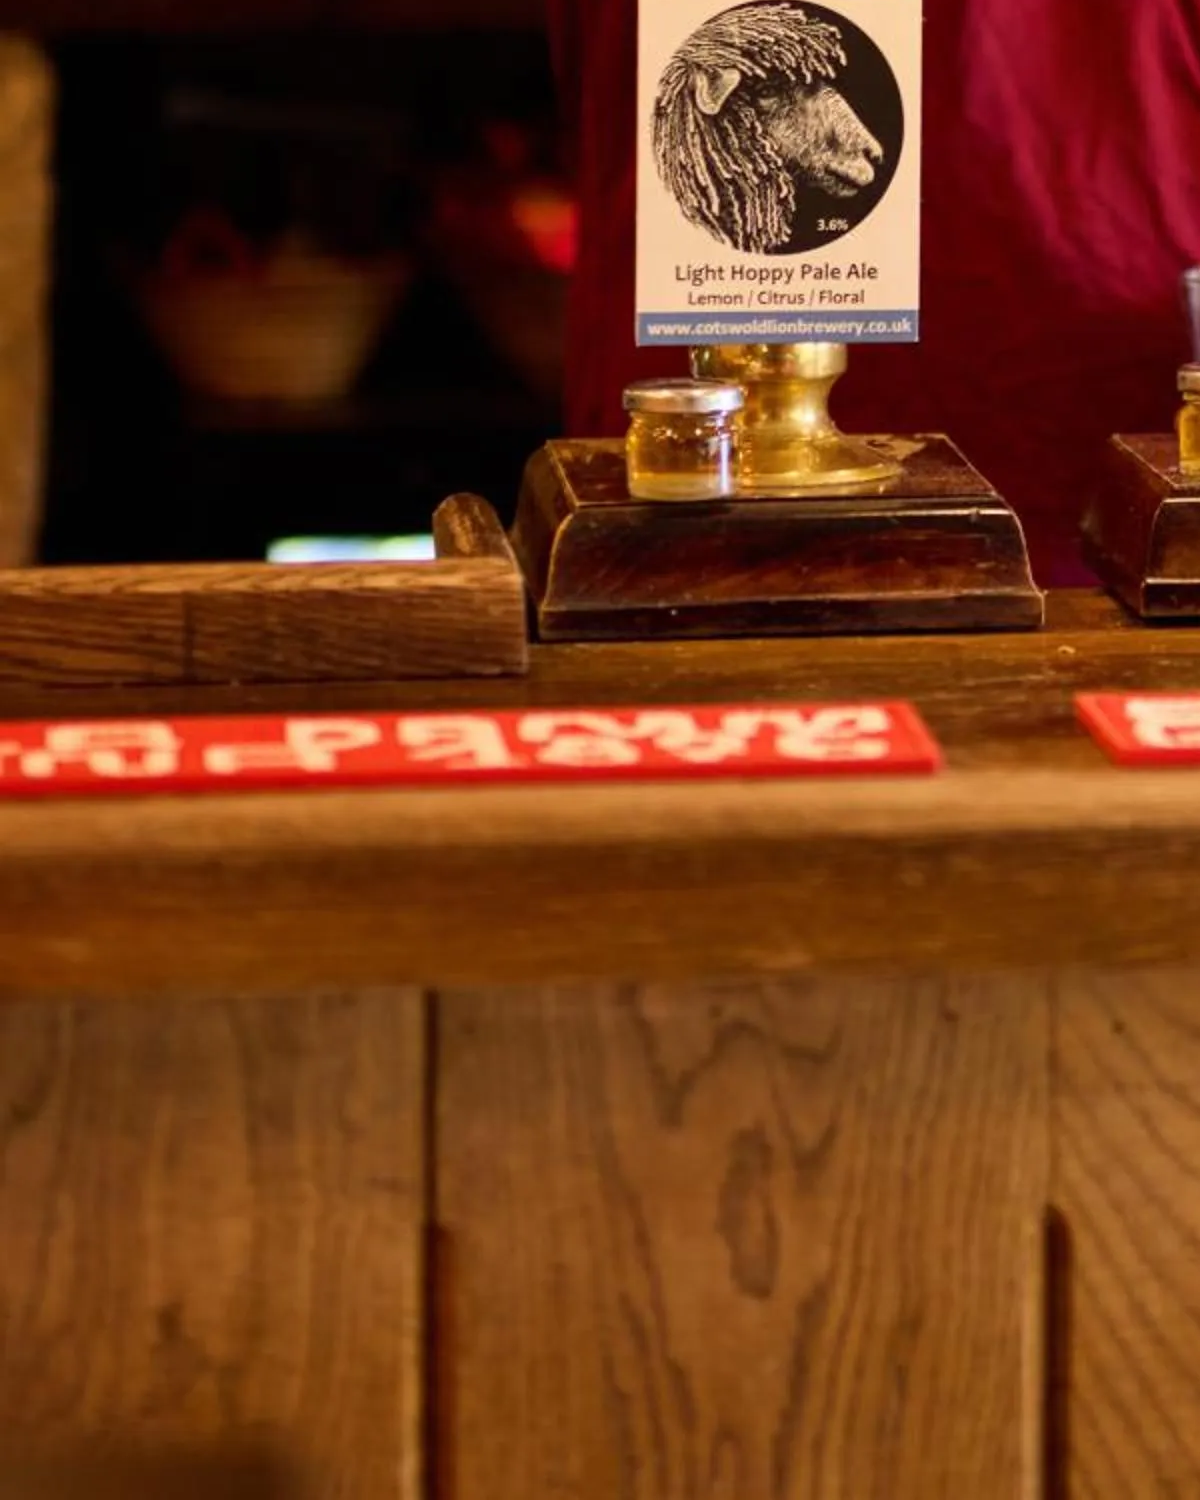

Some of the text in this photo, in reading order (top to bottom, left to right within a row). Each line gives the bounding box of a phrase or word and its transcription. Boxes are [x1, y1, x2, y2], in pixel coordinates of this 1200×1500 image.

[816, 219, 848, 232] 3.6%
[675, 263, 879, 286] Light Hoppy Pale Ale
[687, 291, 744, 306] Lemon
[756, 290, 806, 306] Citrus
[818, 289, 866, 305] Floral
[647, 318, 912, 337] www.cotswoldlionbrewery.co.uk
